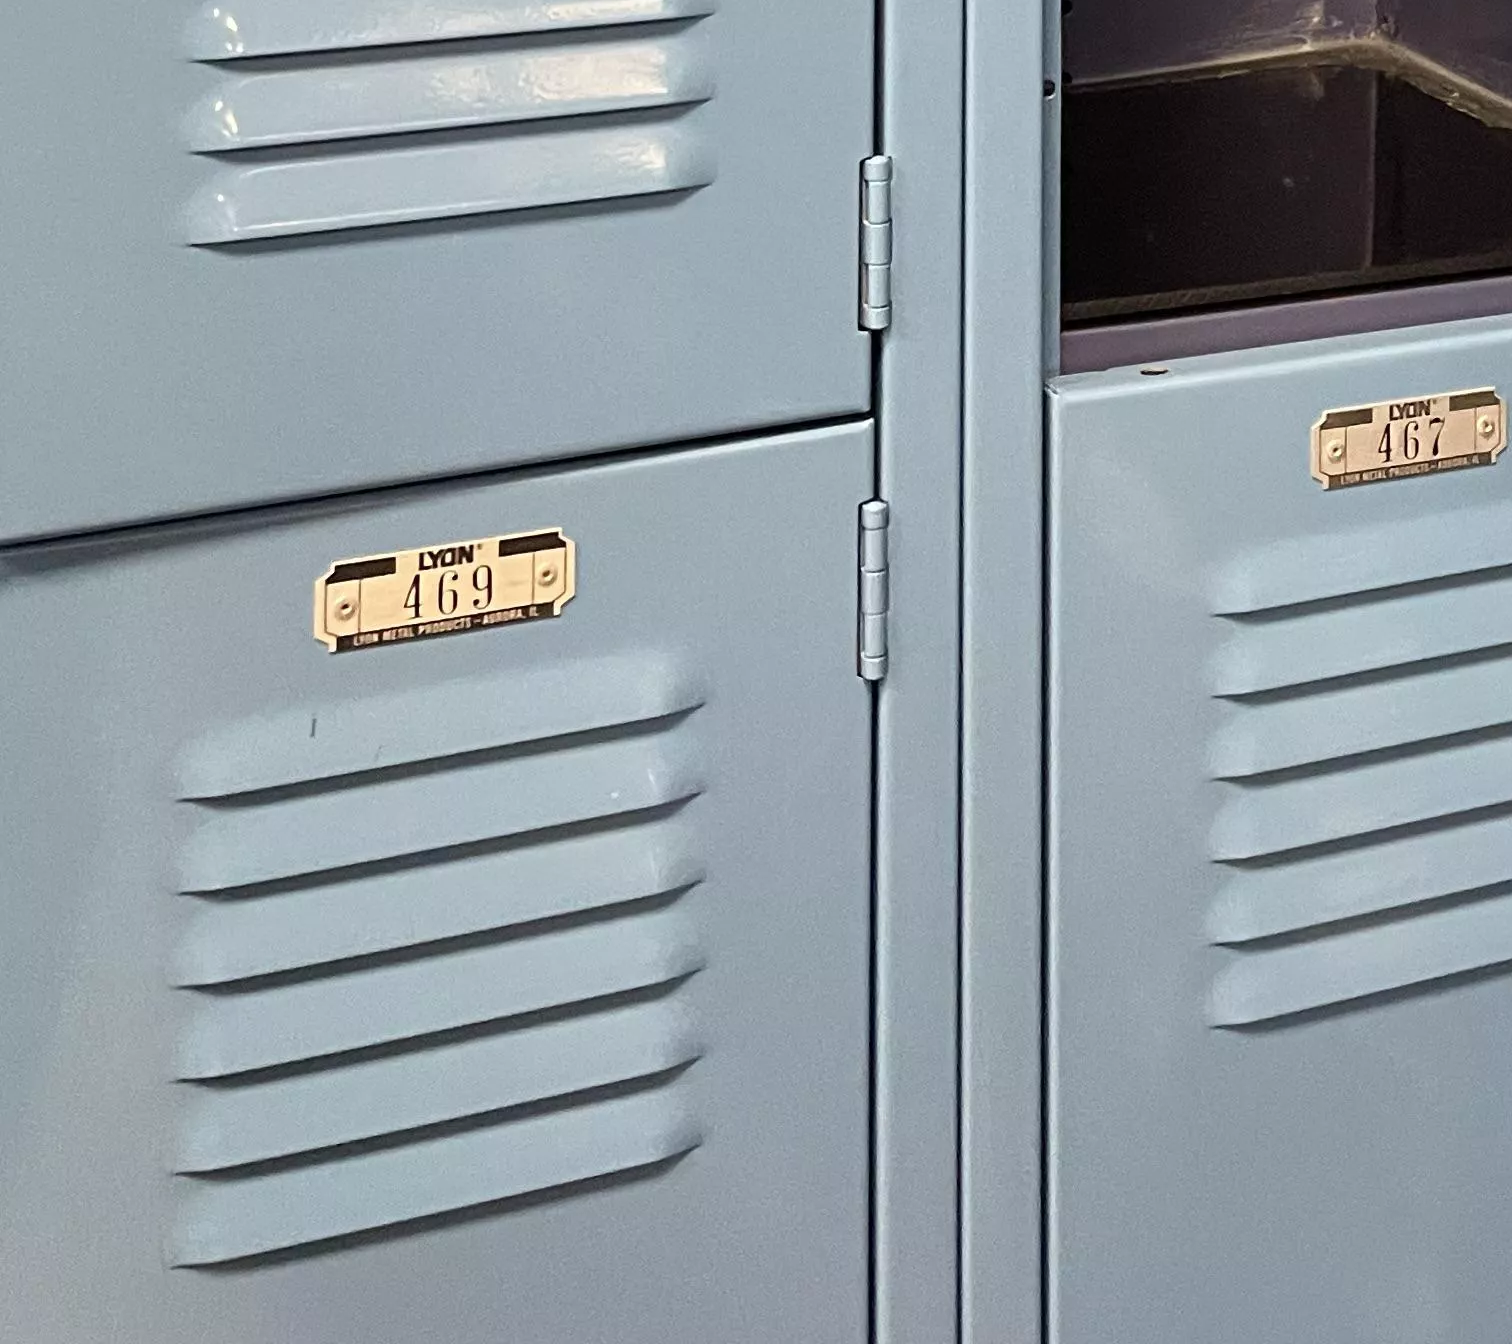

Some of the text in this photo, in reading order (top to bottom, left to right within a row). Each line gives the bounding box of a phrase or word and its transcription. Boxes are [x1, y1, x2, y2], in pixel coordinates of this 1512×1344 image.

[1389, 399, 1431, 422] LYON
[1378, 417, 1445, 463] 467
[418, 544, 475, 571] LYON
[403, 565, 493, 620] 469
